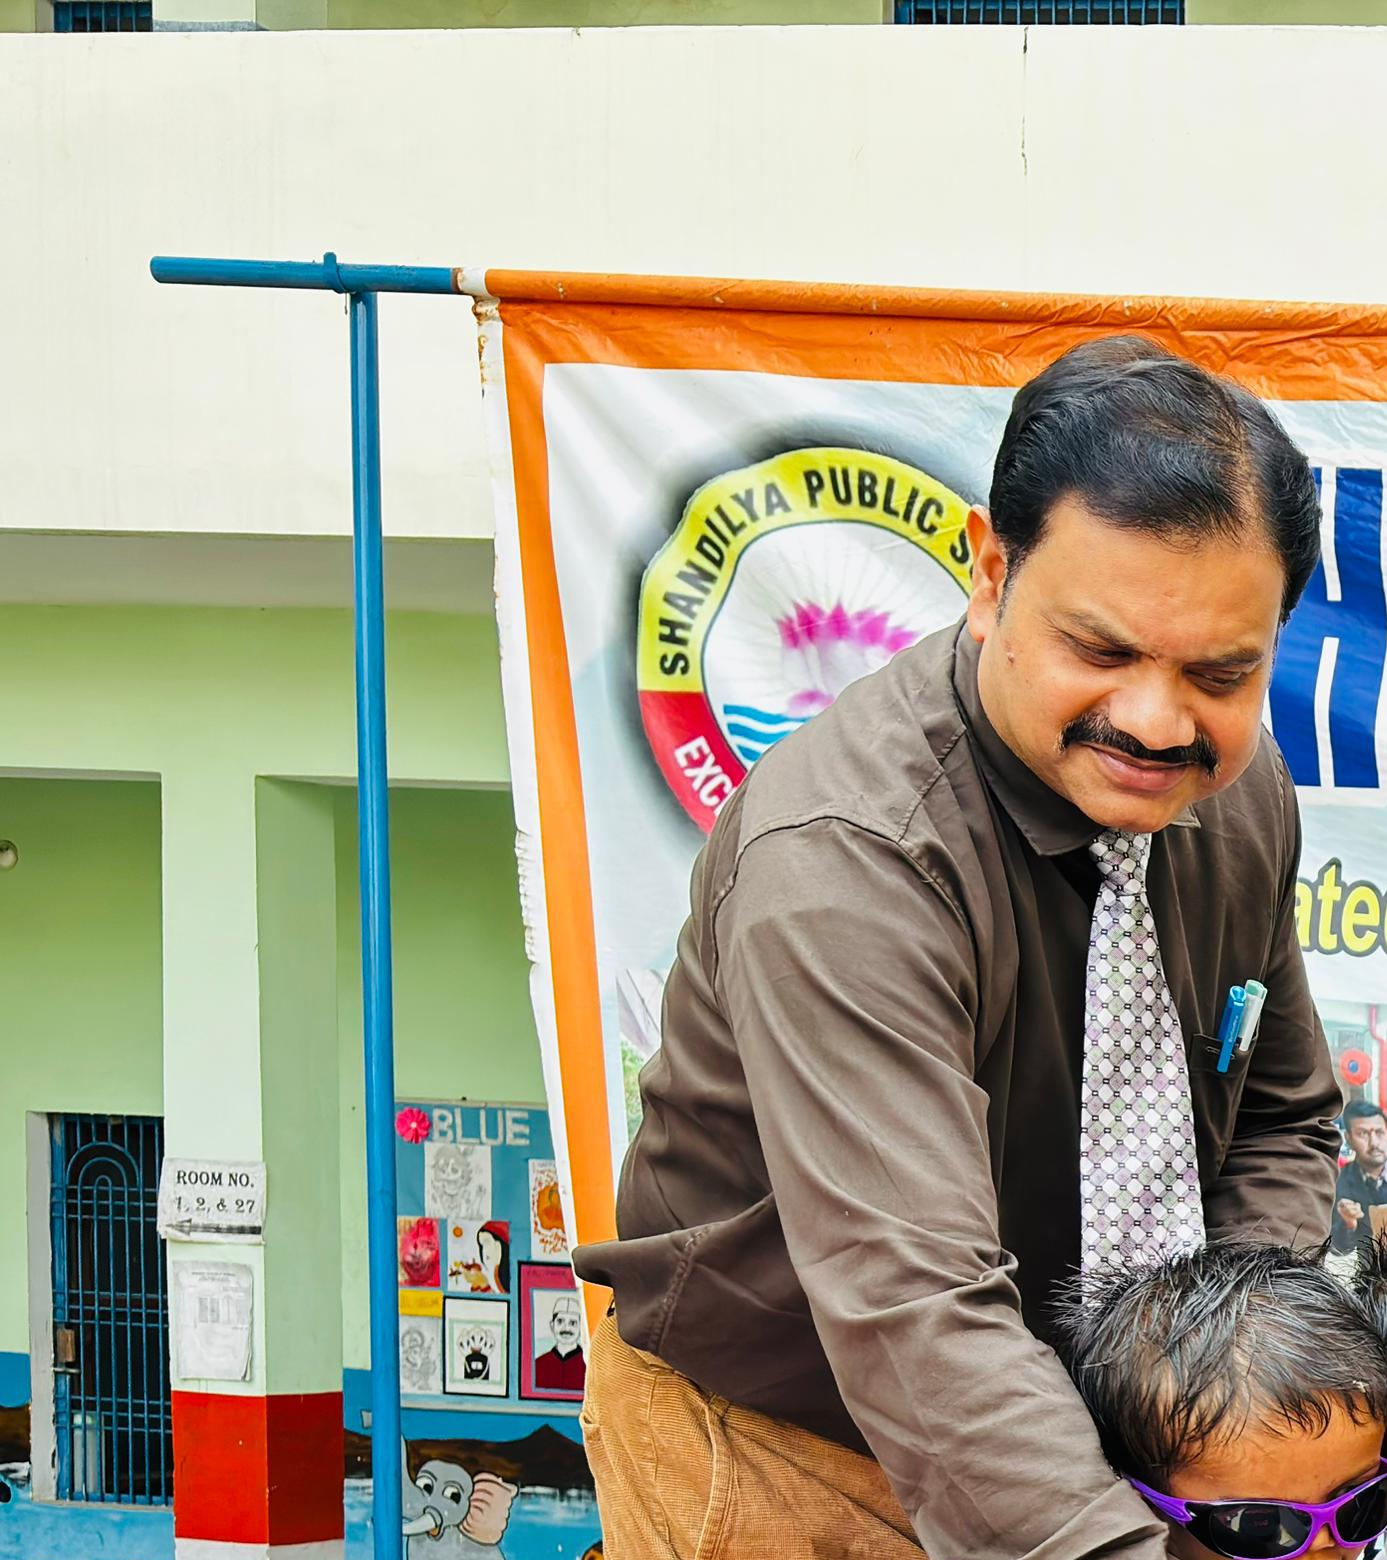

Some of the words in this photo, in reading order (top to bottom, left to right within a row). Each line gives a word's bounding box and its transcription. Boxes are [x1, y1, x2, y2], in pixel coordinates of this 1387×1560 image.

[657, 480, 792, 677] SHANDILYA
[804, 465, 944, 538] PUBLIC
[948, 528, 975, 588] S
[674, 735, 735, 818] EXC
[432, 1107, 530, 1146] BLUE
[177, 1169, 223, 1187] ROOM
[228, 1173, 255, 1188] NO.
[196, 1197, 211, 1213] 2,
[216, 1198, 229, 1213] &
[235, 1199, 256, 1214] 27
